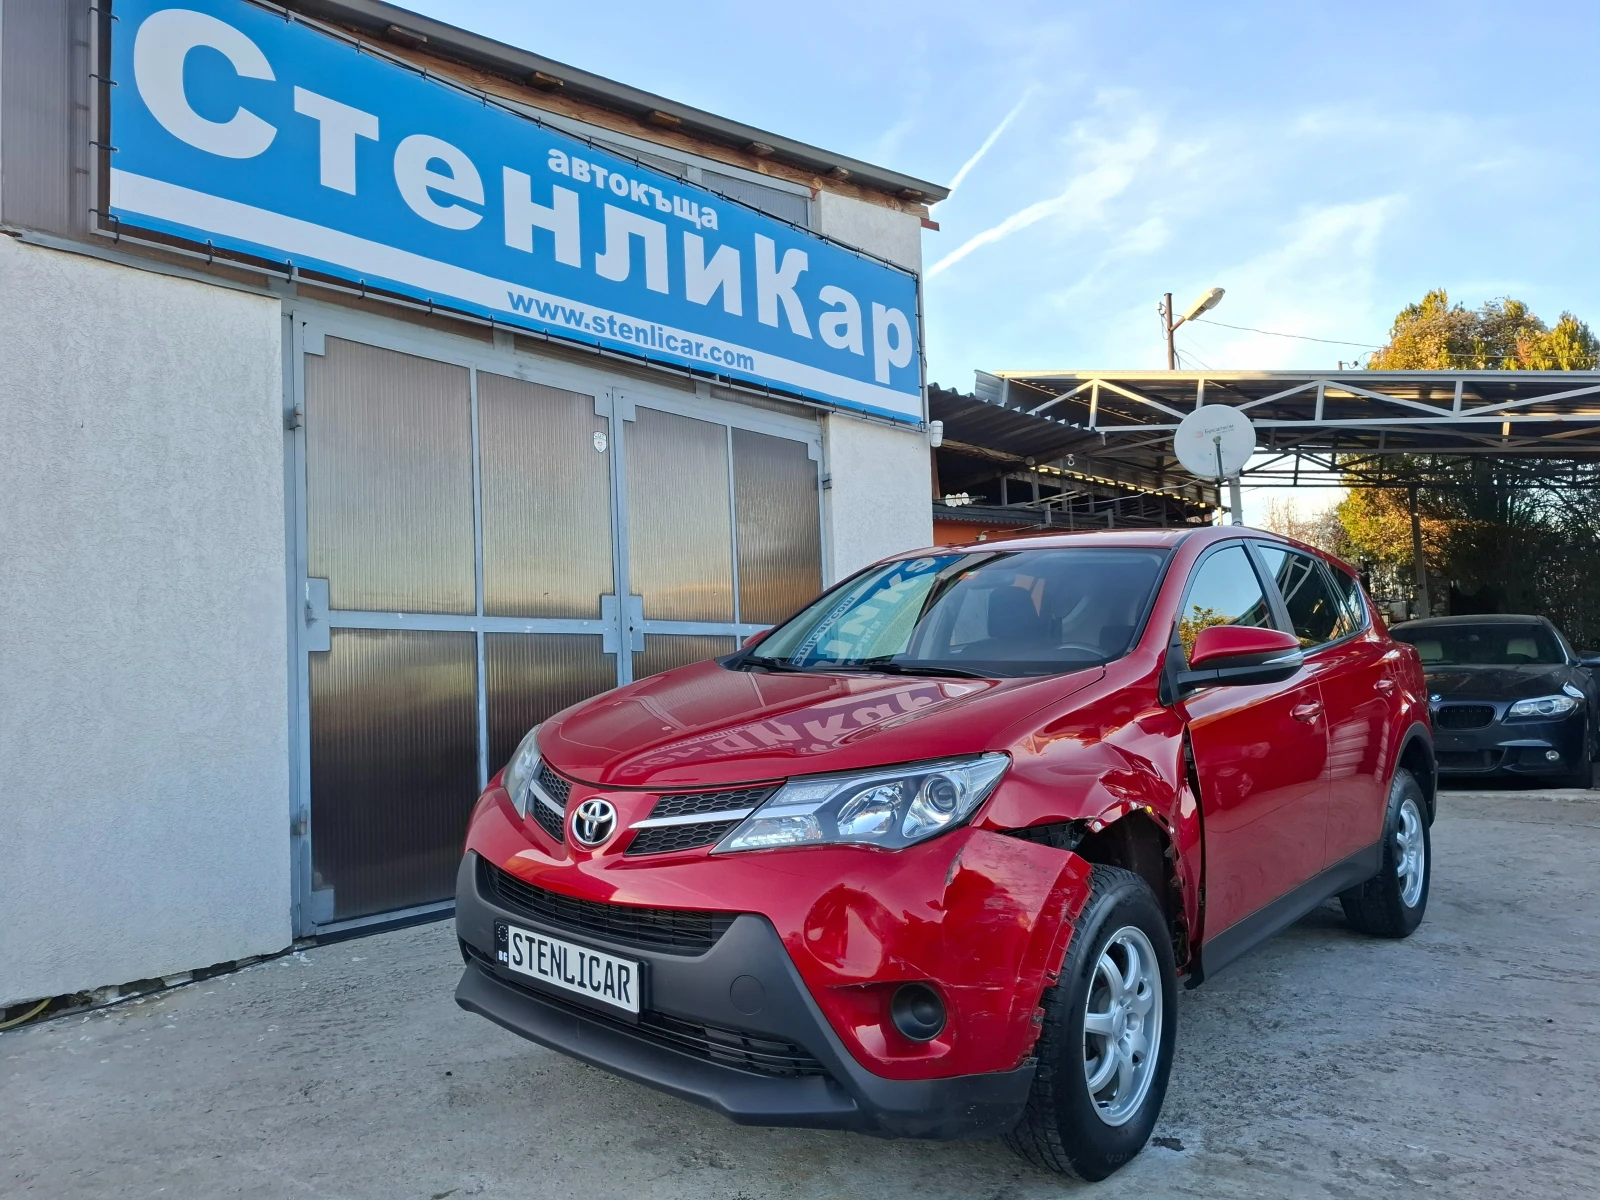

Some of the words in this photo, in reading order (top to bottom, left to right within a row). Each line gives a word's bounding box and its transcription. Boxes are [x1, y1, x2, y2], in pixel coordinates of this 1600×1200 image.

[134, 9, 913, 384] СтенлиКар
[548, 149, 718, 230] автокъща
[508, 292, 755, 371] www.stenlicar.com
[498, 950, 508, 963] BG
[512, 932, 631, 1004] STENLICAR
